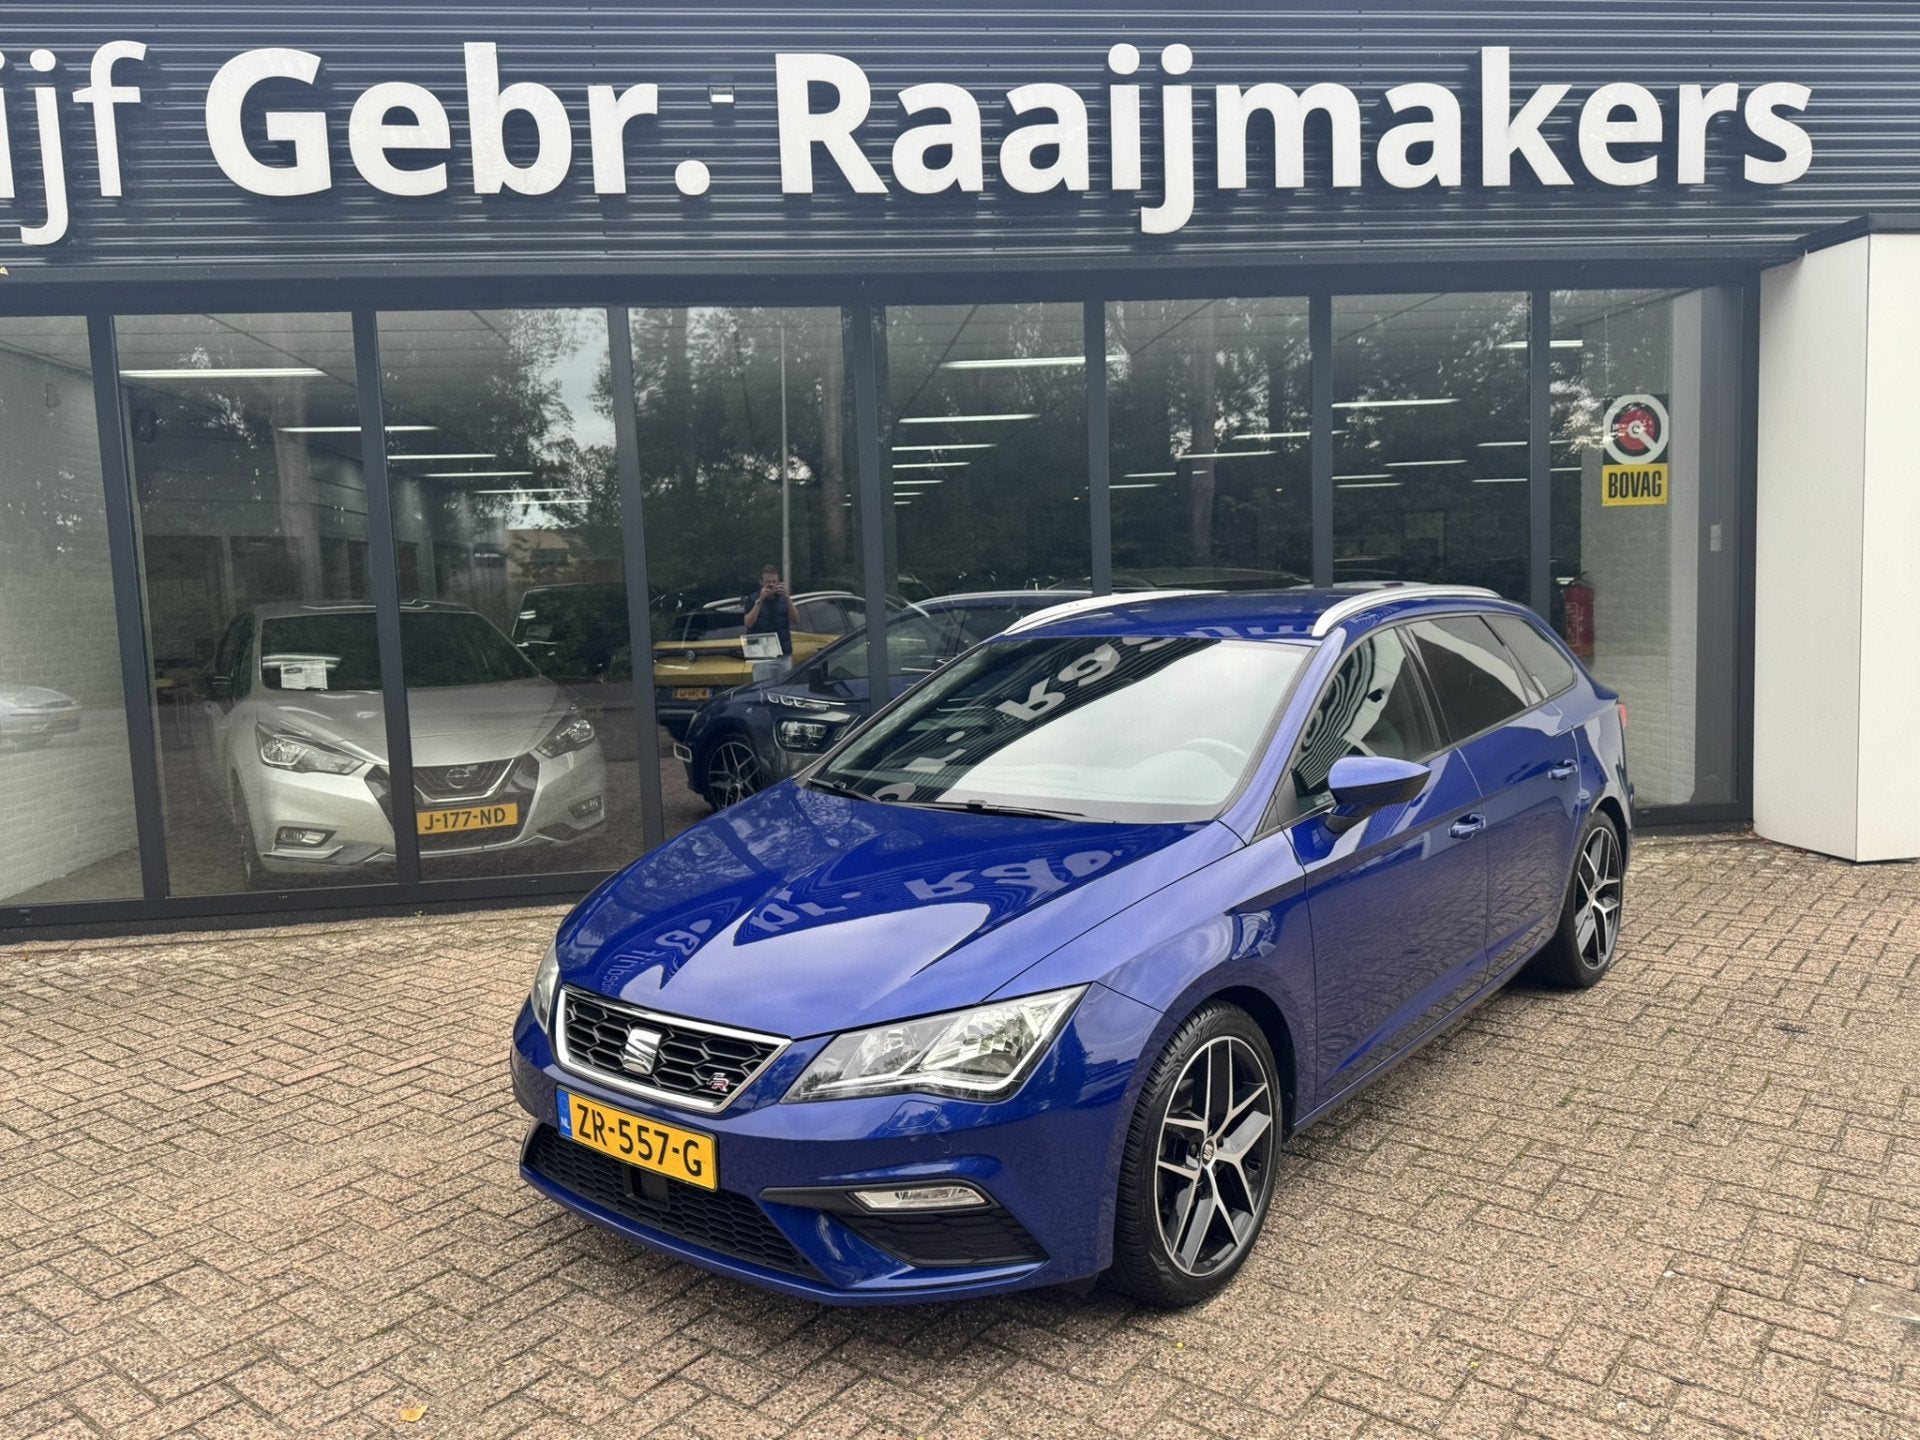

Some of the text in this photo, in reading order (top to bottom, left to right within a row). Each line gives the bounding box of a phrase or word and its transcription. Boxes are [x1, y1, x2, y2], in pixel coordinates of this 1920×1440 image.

[205, 42, 711, 197] Gebr.
[775, 43, 1813, 235] Raaijmakers
[1608, 470, 1662, 499] BOVAG
[424, 806, 506, 831] J-177-ND
[577, 1103, 702, 1177] ZR-557-G
